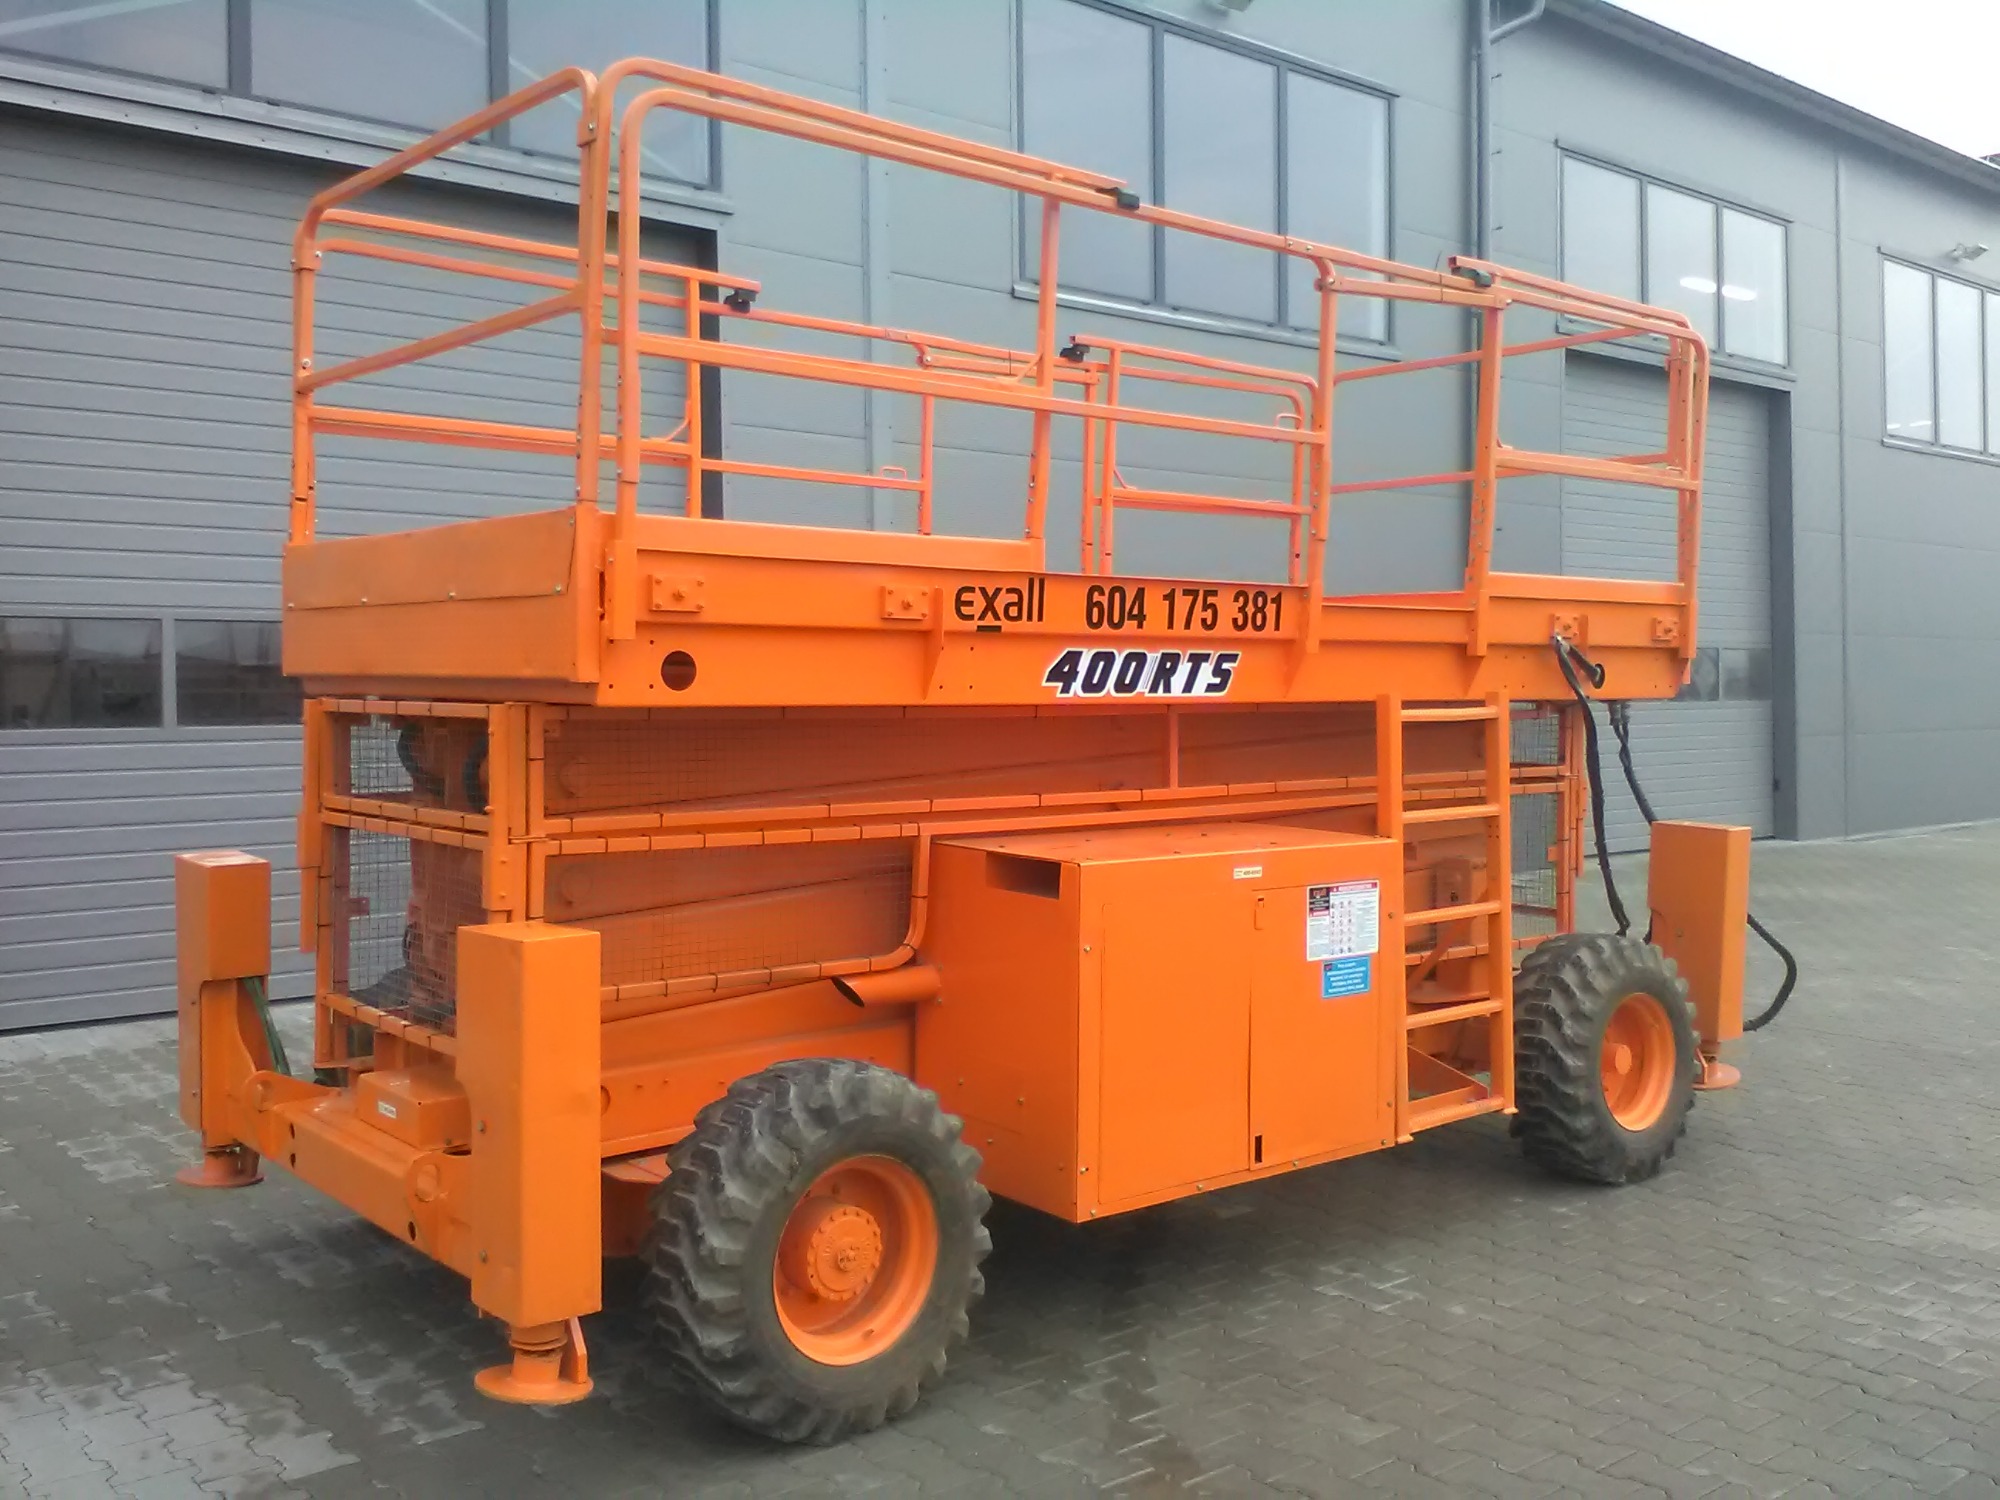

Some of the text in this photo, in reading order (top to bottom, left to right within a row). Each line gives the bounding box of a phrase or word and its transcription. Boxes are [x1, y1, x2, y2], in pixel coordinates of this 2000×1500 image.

[954, 577, 1283, 632] exall 604 175 381
